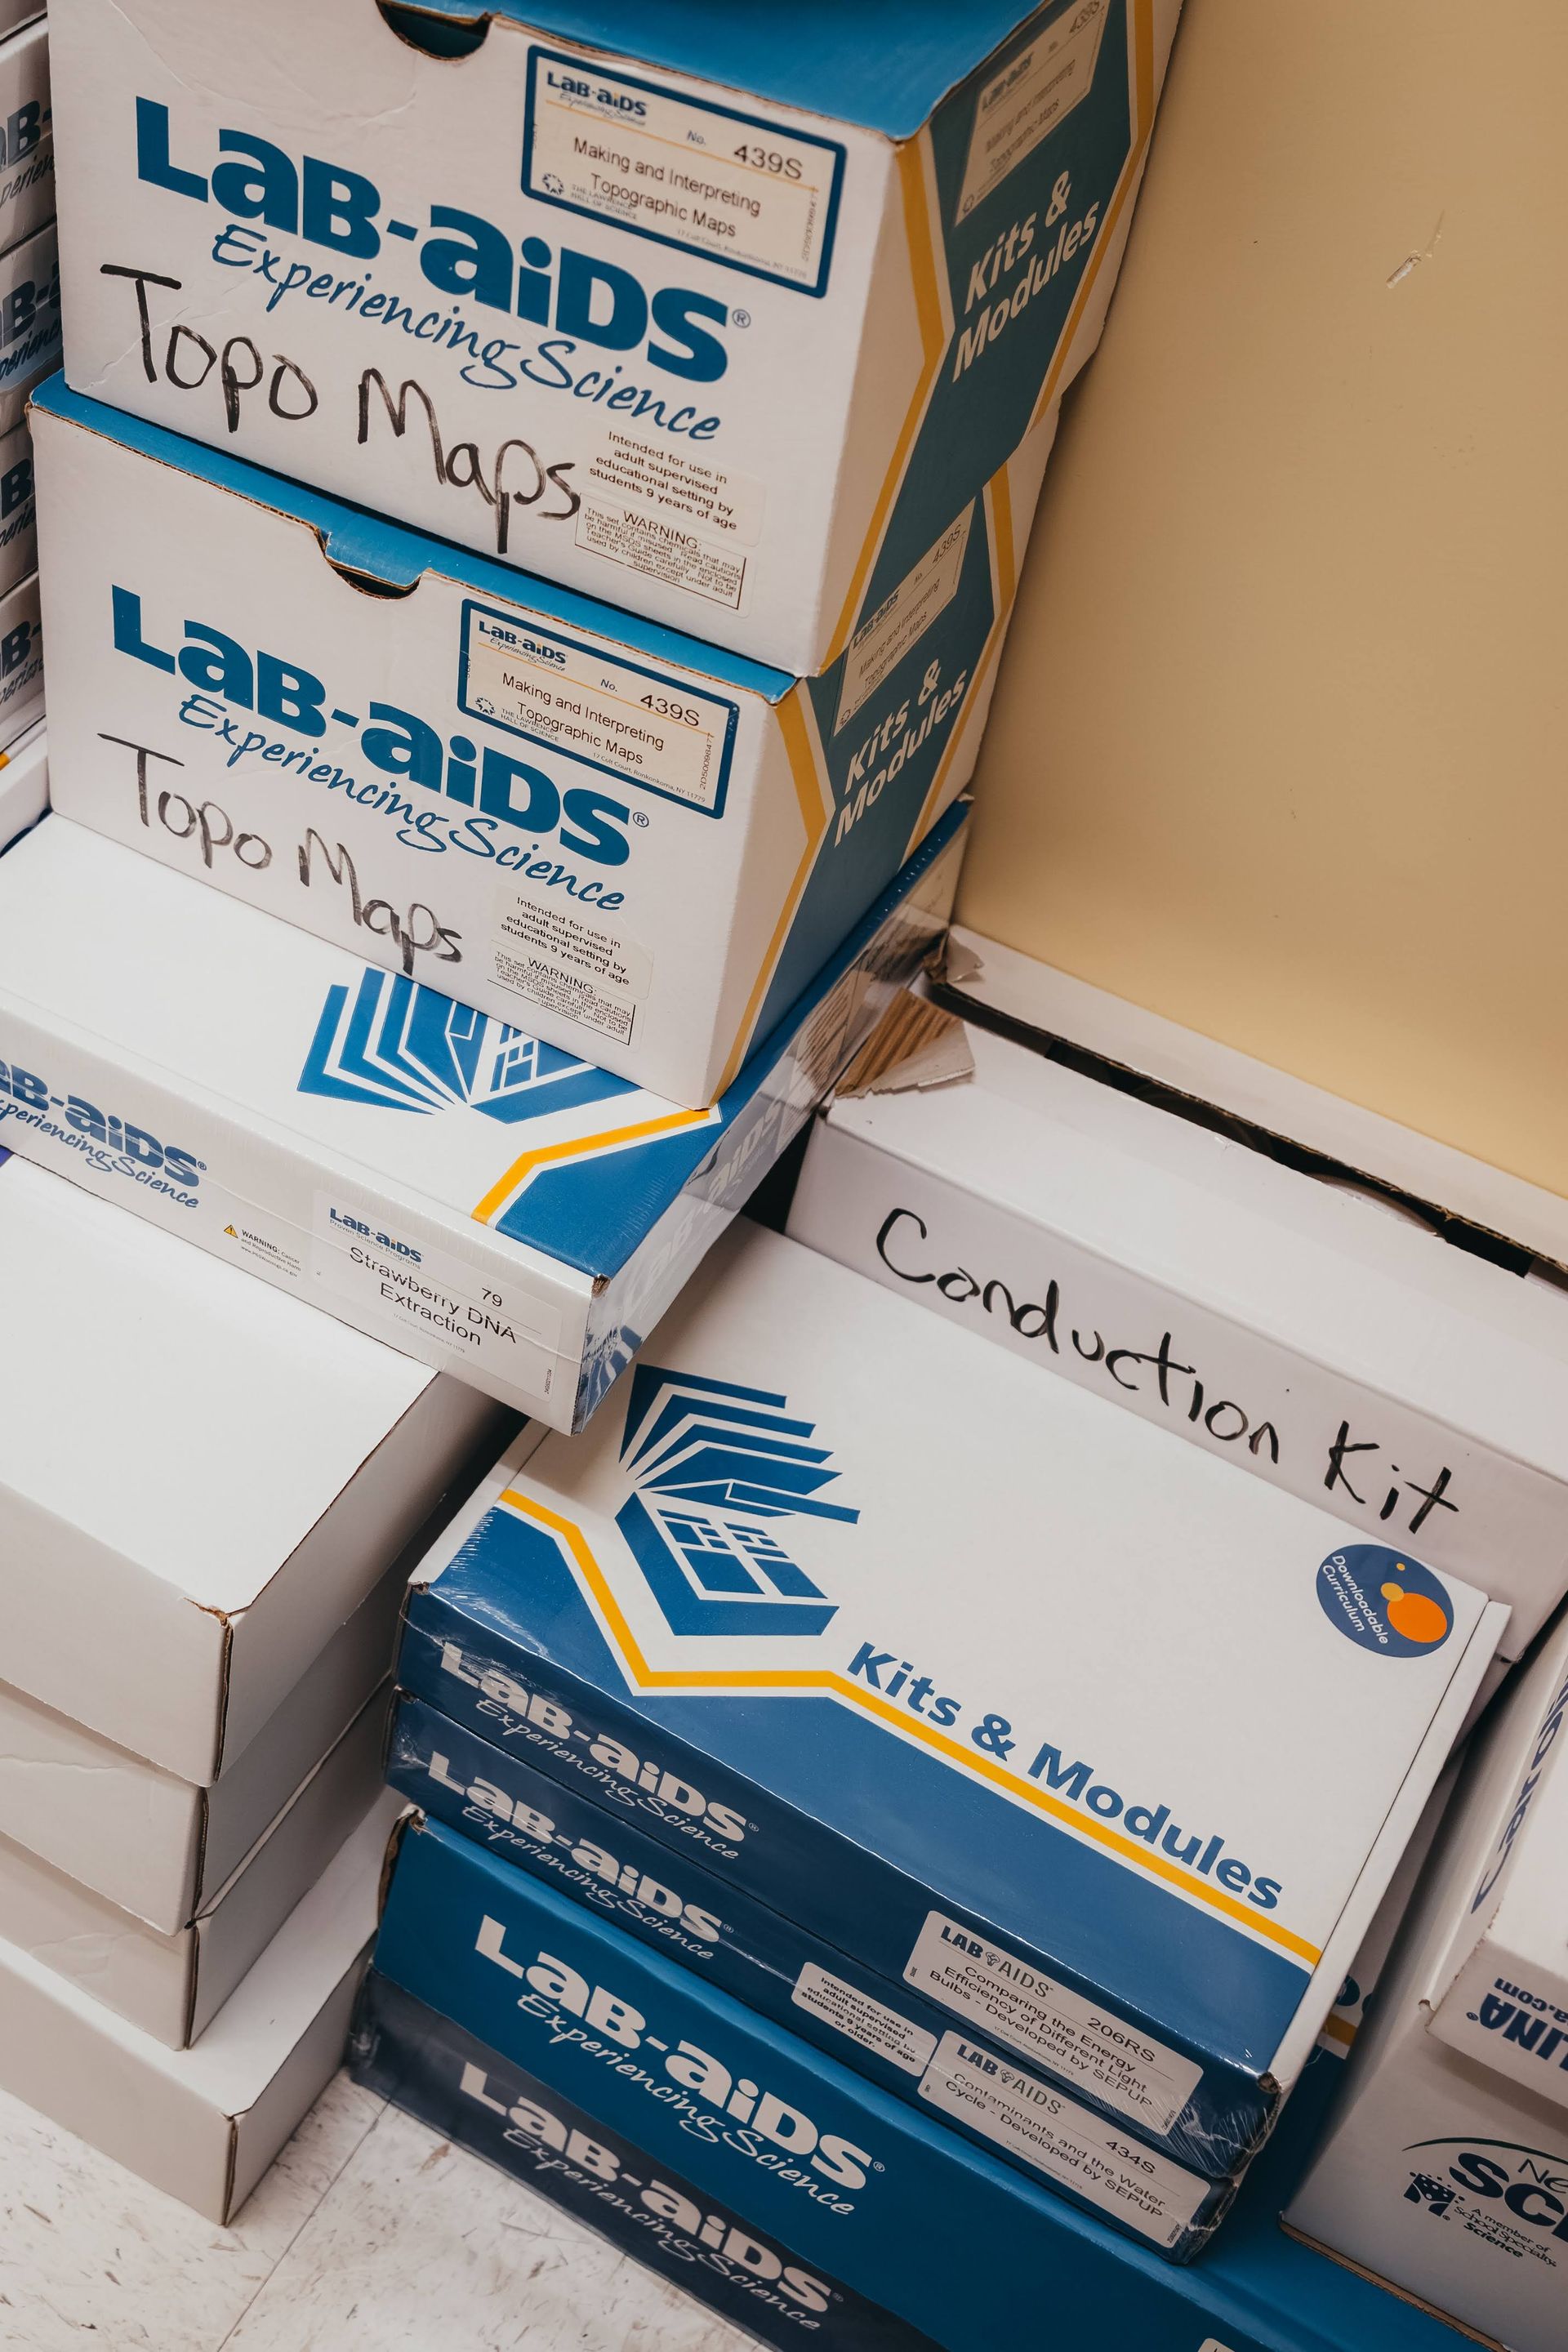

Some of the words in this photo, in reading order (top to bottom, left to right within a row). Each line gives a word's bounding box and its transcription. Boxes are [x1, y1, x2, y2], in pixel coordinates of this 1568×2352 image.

[574, 137, 630, 172] Making
[635, 160, 663, 181] and
[670, 169, 761, 217] Interpreting
[687, 130, 706, 145] No.
[734, 145, 803, 180] 439S
[591, 173, 687, 220] Topographic
[693, 209, 736, 237] Maps
[964, 212, 1038, 314] Kits
[1045, 170, 1072, 227] &
[952, 201, 1099, 383] Modules
[212, 225, 520, 389] Experiencing
[520, 341, 720, 439] Science
[100, 263, 318, 432] Topo
[358, 368, 581, 554] Maps
[596, 457, 669, 490] educational
[672, 485, 713, 510] setting
[719, 502, 733, 515] by
[608, 432, 663, 459] Intended
[669, 454, 685, 468] for
[689, 463, 711, 477] use
[716, 471, 727, 484] in
[614, 449, 645, 466] adult
[649, 461, 718, 495] supervised
[590, 467, 642, 494] students
[647, 488, 654, 497] 9
[658, 493, 693, 514] years
[697, 508, 709, 519] of
[713, 515, 737, 530] age
[624, 511, 702, 550] WARNING:
[503, 673, 551, 705] Making
[555, 698, 581, 715] and
[586, 706, 664, 751] Interpreting
[518, 702, 601, 746] Topographic
[606, 740, 643, 764] Maps
[601, 679, 617, 692] No.
[639, 695, 700, 727] 439S
[844, 699, 910, 795] Kits
[918, 658, 941, 706] &
[835, 669, 967, 848] Modules
[178, 694, 449, 852] Experiencing
[449, 818, 625, 910] Science
[96, 733, 273, 869] Topo
[298, 827, 462, 976] Maps
[501, 924, 547, 950] students
[560, 949, 591, 969] years
[595, 963, 606, 975] of
[608, 972, 630, 985] age
[506, 915, 570, 948] educational
[573, 944, 610, 967] setting
[614, 961, 627, 973] by
[517, 897, 566, 924] Intended
[569, 920, 584, 932] for
[587, 930, 607, 942] use
[611, 938, 621, 948] in
[522, 911, 550, 928] adult
[552, 924, 612, 956] supervised
[528, 958, 597, 996] WARNING:
[112, 1156, 199, 1209] Science
[241, 1229, 279, 1254] WARNING:
[330, 1218, 354, 1233] Proven
[356, 1232, 384, 1250] Science
[385, 1247, 421, 1269] Programs
[350, 1247, 460, 1315] Strawberry
[467, 1307, 516, 1343] DNA
[379, 1282, 481, 1346] Extraction
[481, 1288, 502, 1307] 79
[876, 1208, 1280, 1464] Conduction
[1325, 1420, 1460, 1535] Kit
[1323, 1565, 1365, 1632] Curriculum
[1332, 1555, 1388, 1644] Downloadable
[475, 1699, 638, 1806] Experiencing
[638, 1797, 739, 1860] Science
[847, 1642, 962, 1726] Kits
[971, 1713, 1016, 1762] &
[1027, 1742, 1283, 1909] Modules
[462, 1806, 617, 1908] Experiencing
[617, 1900, 714, 1959] Science
[941, 1926, 984, 1959] LAB
[998, 1961, 1050, 1998] AIDS
[801, 1992, 844, 2020] students
[855, 2024, 882, 2042] years
[884, 2041, 895, 2050] of
[897, 2051, 915, 2063] age
[807, 1987, 864, 2023] educational
[821, 1977, 864, 2006] Intended
[867, 2005, 881, 2016] for
[884, 2016, 901, 2029] use
[904, 2027, 914, 2036] in
[823, 1988, 849, 2007] adult
[850, 2005, 906, 2040] supervised
[835, 2020, 845, 2029] or
[848, 2027, 875, 2047] older.
[929, 1971, 971, 2000] Bulbs
[986, 2004, 1067, 2058] Developed
[1070, 2054, 1090, 2071] by
[944, 1967, 1017, 2015] Efficiency
[1020, 2013, 1037, 2025] of
[1040, 2022, 1105, 2068] Different
[1108, 2065, 1147, 2095] Light
[964, 1967, 1047, 2021] Comparing
[1052, 2019, 1076, 2037] the
[1080, 2035, 1136, 2074] Energy
[1087, 2017, 1156, 2062] 206RS
[517, 1992, 724, 2143] Experiencing
[724, 2129, 855, 2216] Science
[956, 2043, 999, 2076] LAB
[1011, 2078, 1062, 2115] AIDS
[946, 2081, 987, 2115] Cycle
[1000, 2114, 1080, 2167] Developed
[1082, 2164, 1102, 2180] by
[1104, 2179, 1163, 2217] SEPUP
[954, 2074, 1054, 2139] Contaminants
[1058, 2137, 1088, 2159] and
[1091, 2157, 1116, 2176] the
[1120, 2174, 1165, 2207] Water
[1105, 2140, 1156, 2174] 434S
[503, 2128, 698, 2262] Experiencing
[697, 2250, 822, 2331] Science
[1454, 2207, 1498, 2234] School
[1463, 2222, 1523, 2258] Science
[1485, 2216, 1534, 2244] member
[1536, 2243, 1551, 2252] of
